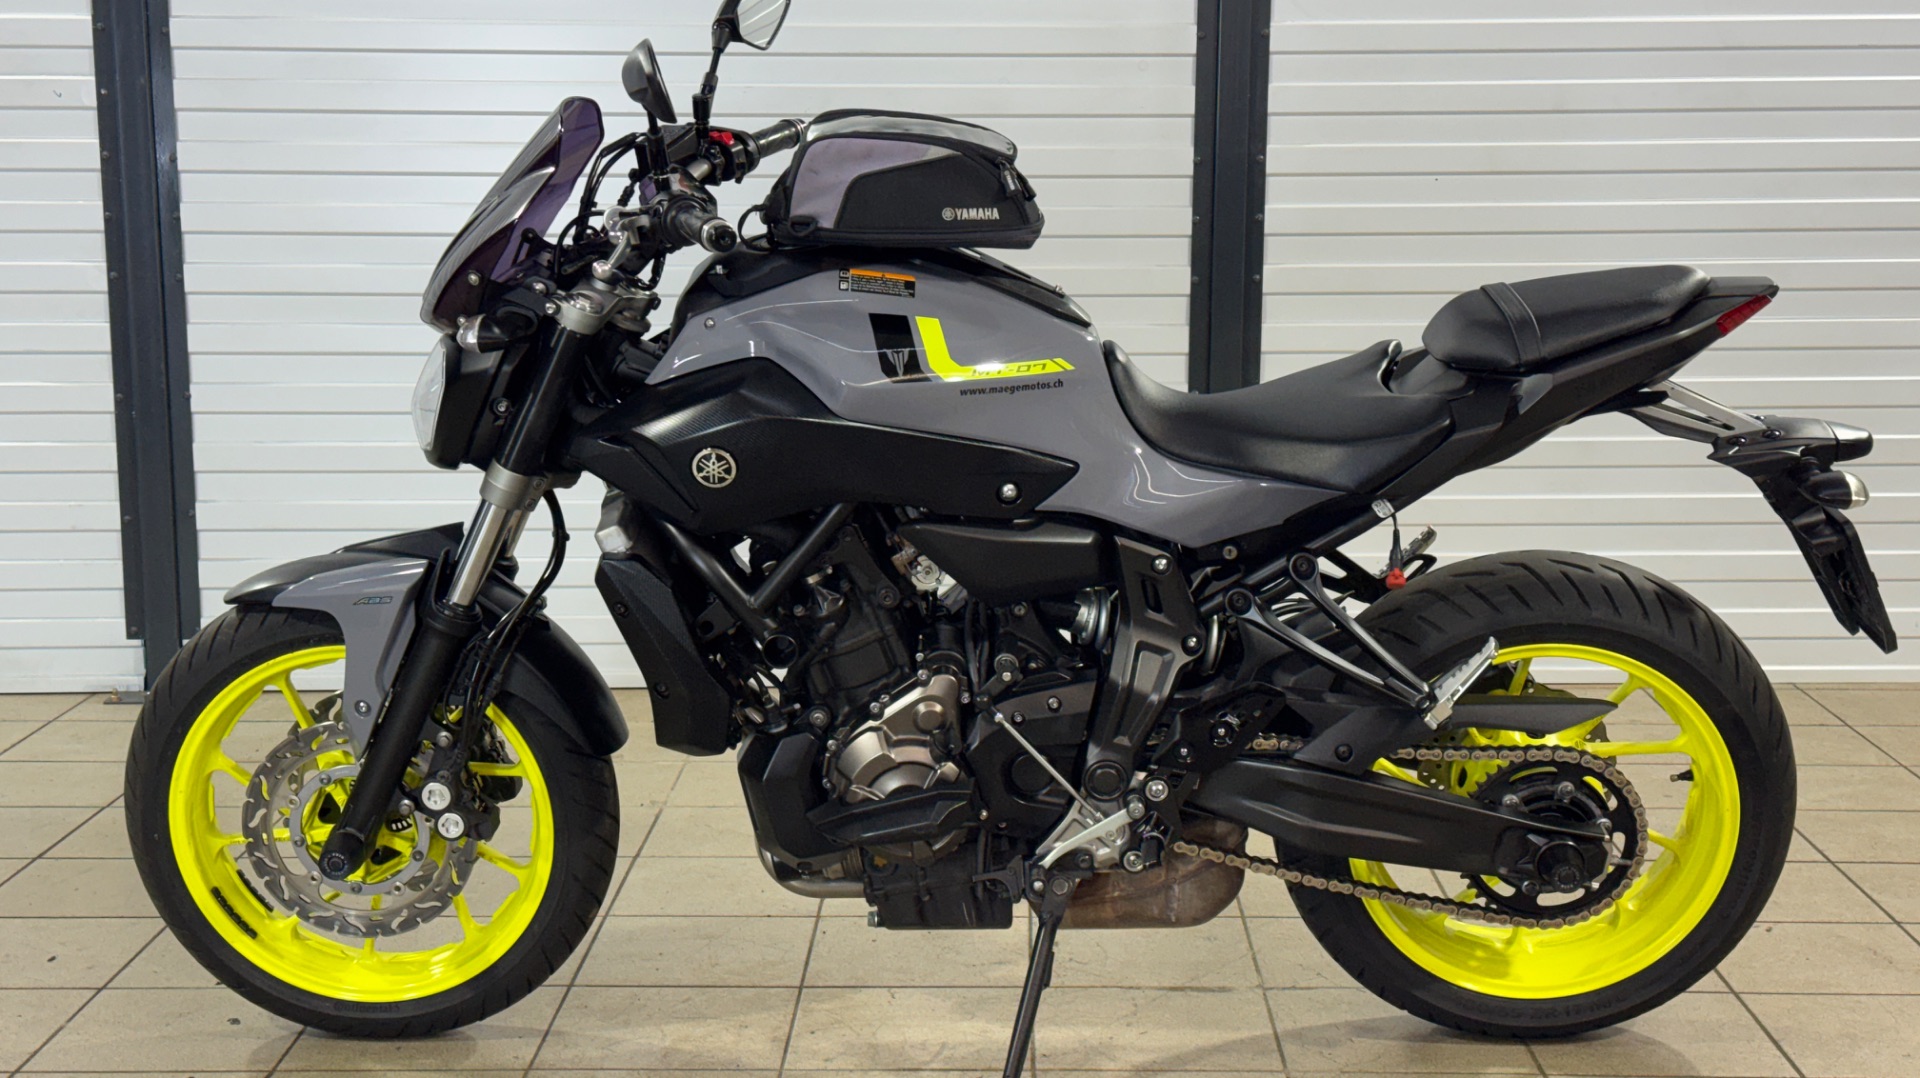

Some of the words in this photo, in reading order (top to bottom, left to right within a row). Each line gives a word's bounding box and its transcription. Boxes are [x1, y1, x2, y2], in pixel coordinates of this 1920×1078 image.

[955, 207, 1000, 220] YAMAHA
[960, 379, 1064, 396] www.maegemotos.ch
[352, 595, 393, 605] ABS
